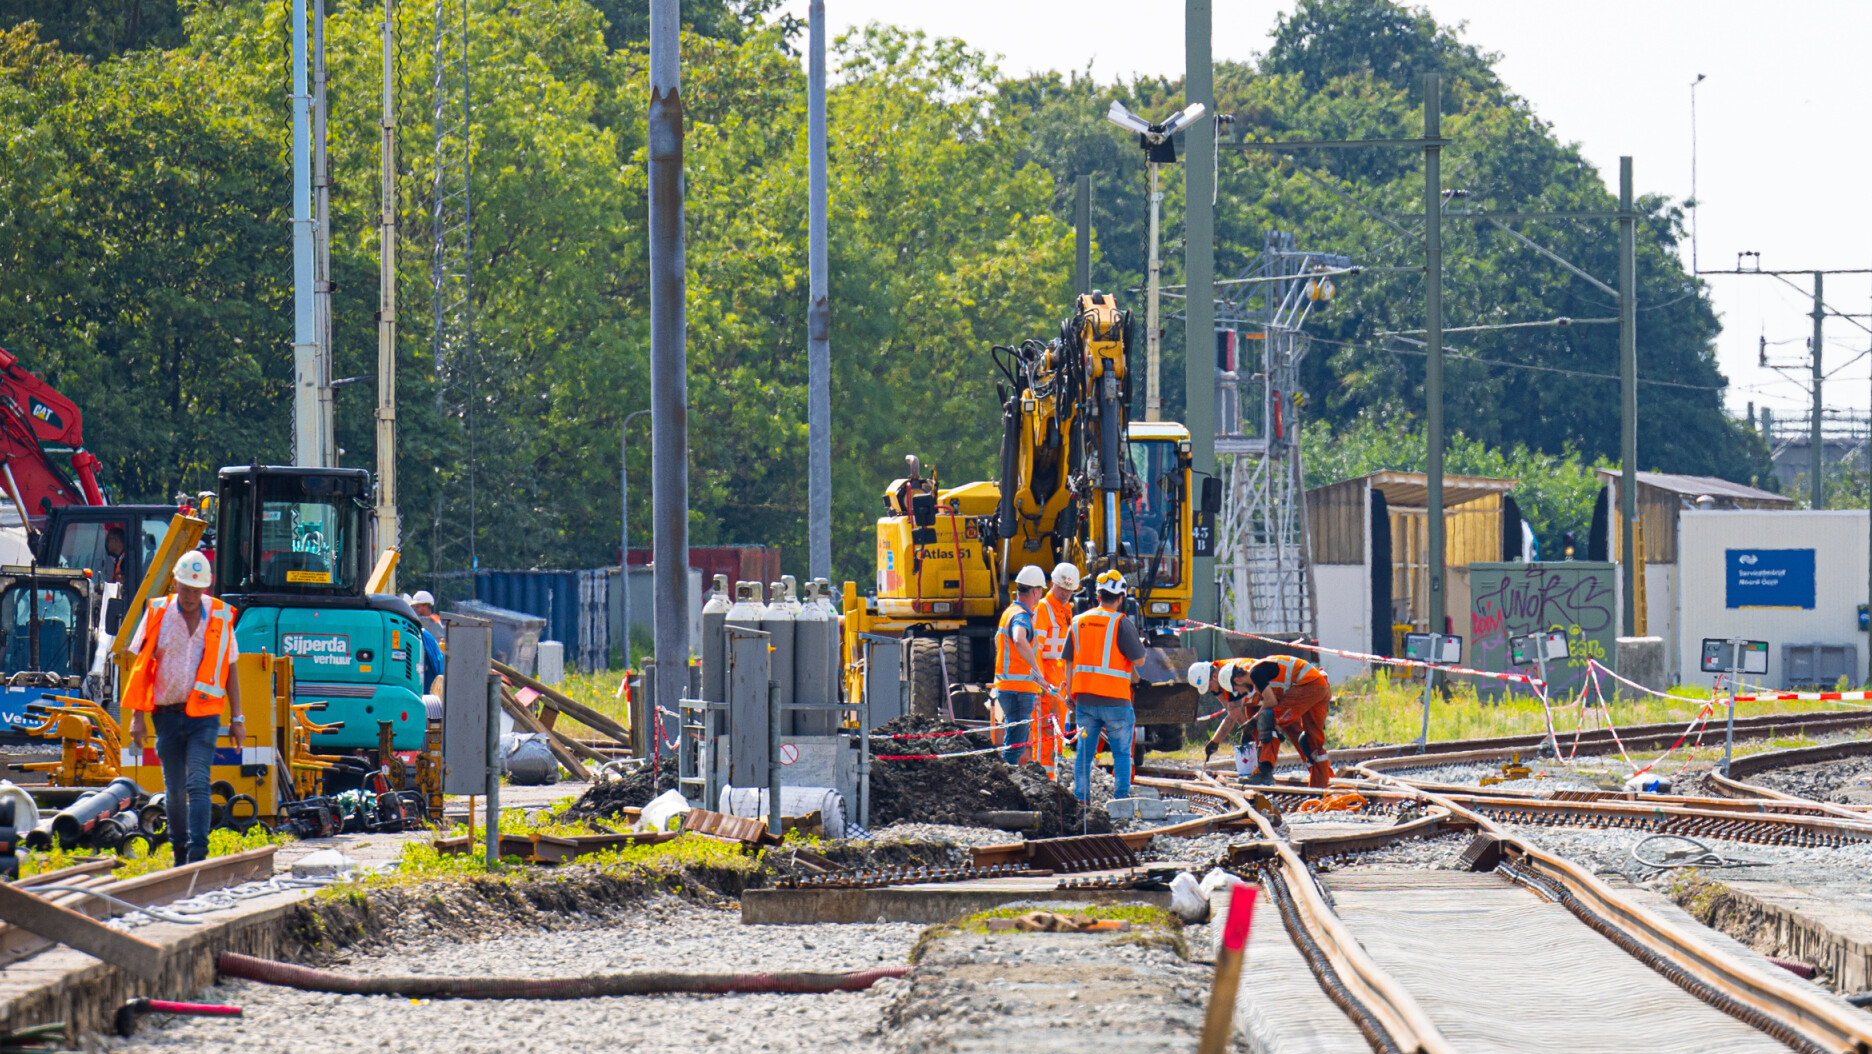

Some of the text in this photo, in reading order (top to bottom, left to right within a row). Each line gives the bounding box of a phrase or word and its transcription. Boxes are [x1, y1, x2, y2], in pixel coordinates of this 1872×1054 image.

[32, 403, 54, 422] CAT
[1197, 539, 1206, 551] B
[922, 548, 954, 560] Atlas
[283, 636, 347, 655] Sijperda
[312, 653, 352, 665] verhuur
